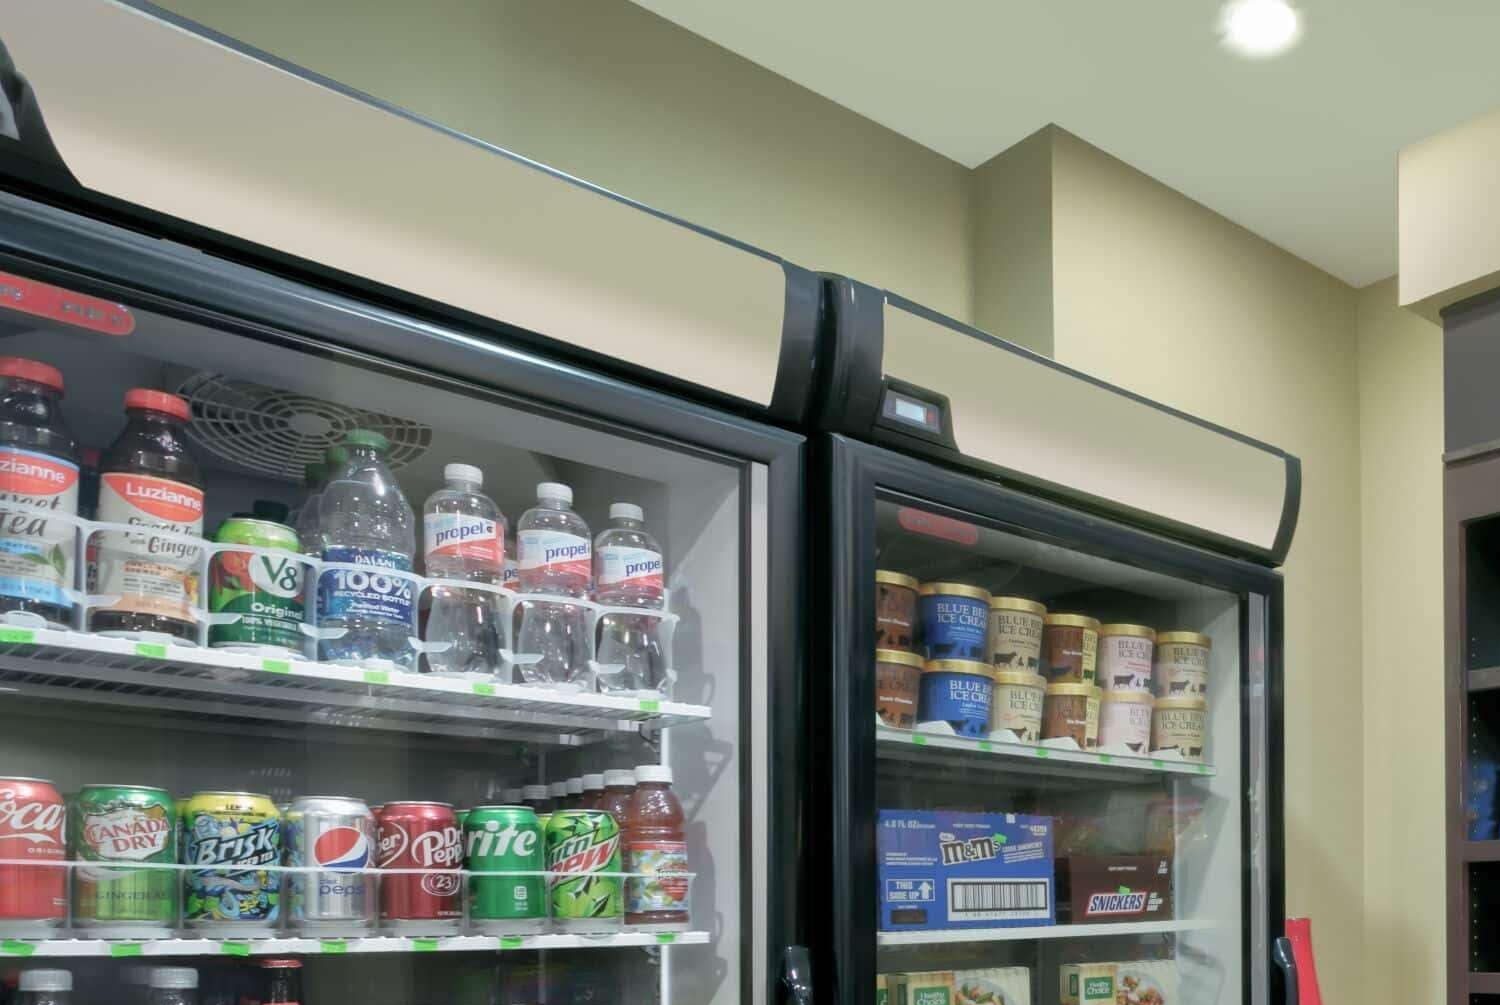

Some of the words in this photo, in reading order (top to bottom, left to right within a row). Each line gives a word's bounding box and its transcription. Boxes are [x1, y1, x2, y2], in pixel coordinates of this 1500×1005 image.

[0, 458, 66, 484] zianne
[126, 482, 202, 512] Luzianne
[436, 521, 485, 546] propel
[545, 541, 589, 561] propel
[261, 554, 297, 591] V8
[625, 558, 663, 575] prope
[334, 570, 411, 600] 100%
[85, 818, 170, 845] CANADA
[112, 834, 159, 853] DRY
[465, 820, 537, 857] rite
[413, 833, 463, 867] Pepp
[320, 883, 365, 898] peps
[1091, 893, 1144, 913] SNICKERS
